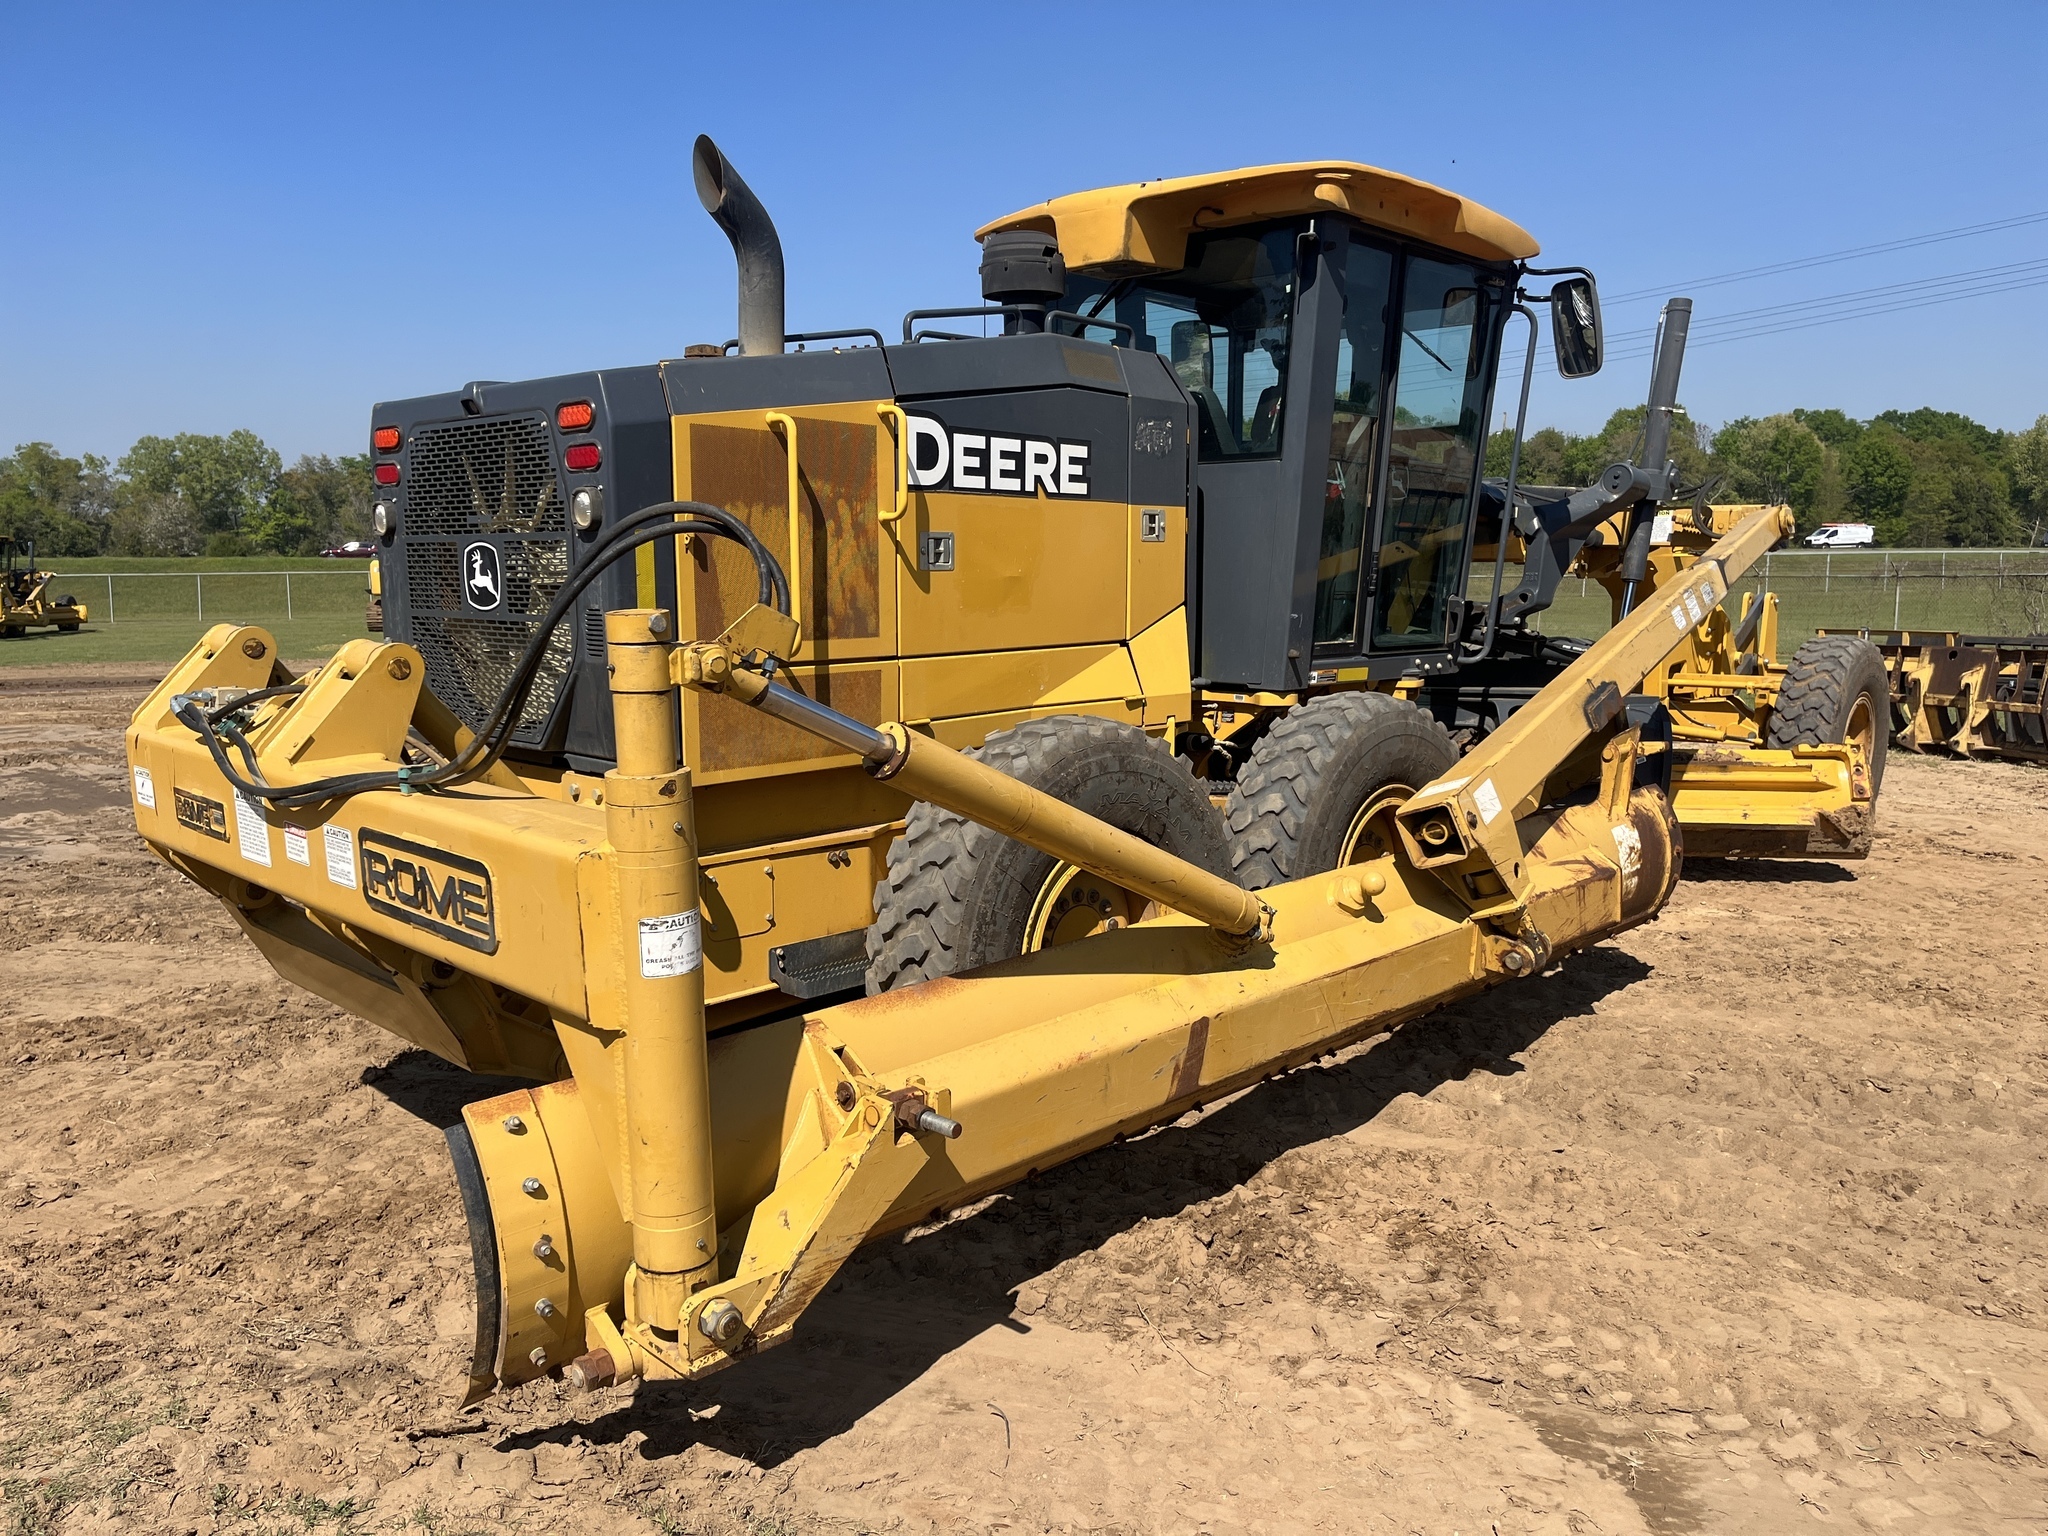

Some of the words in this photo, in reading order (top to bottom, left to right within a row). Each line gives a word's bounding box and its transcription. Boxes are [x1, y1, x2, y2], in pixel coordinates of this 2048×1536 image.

[905, 414, 1089, 495] DEERE
[363, 848, 491, 937] ROME
[665, 912, 700, 930] AUTIO
